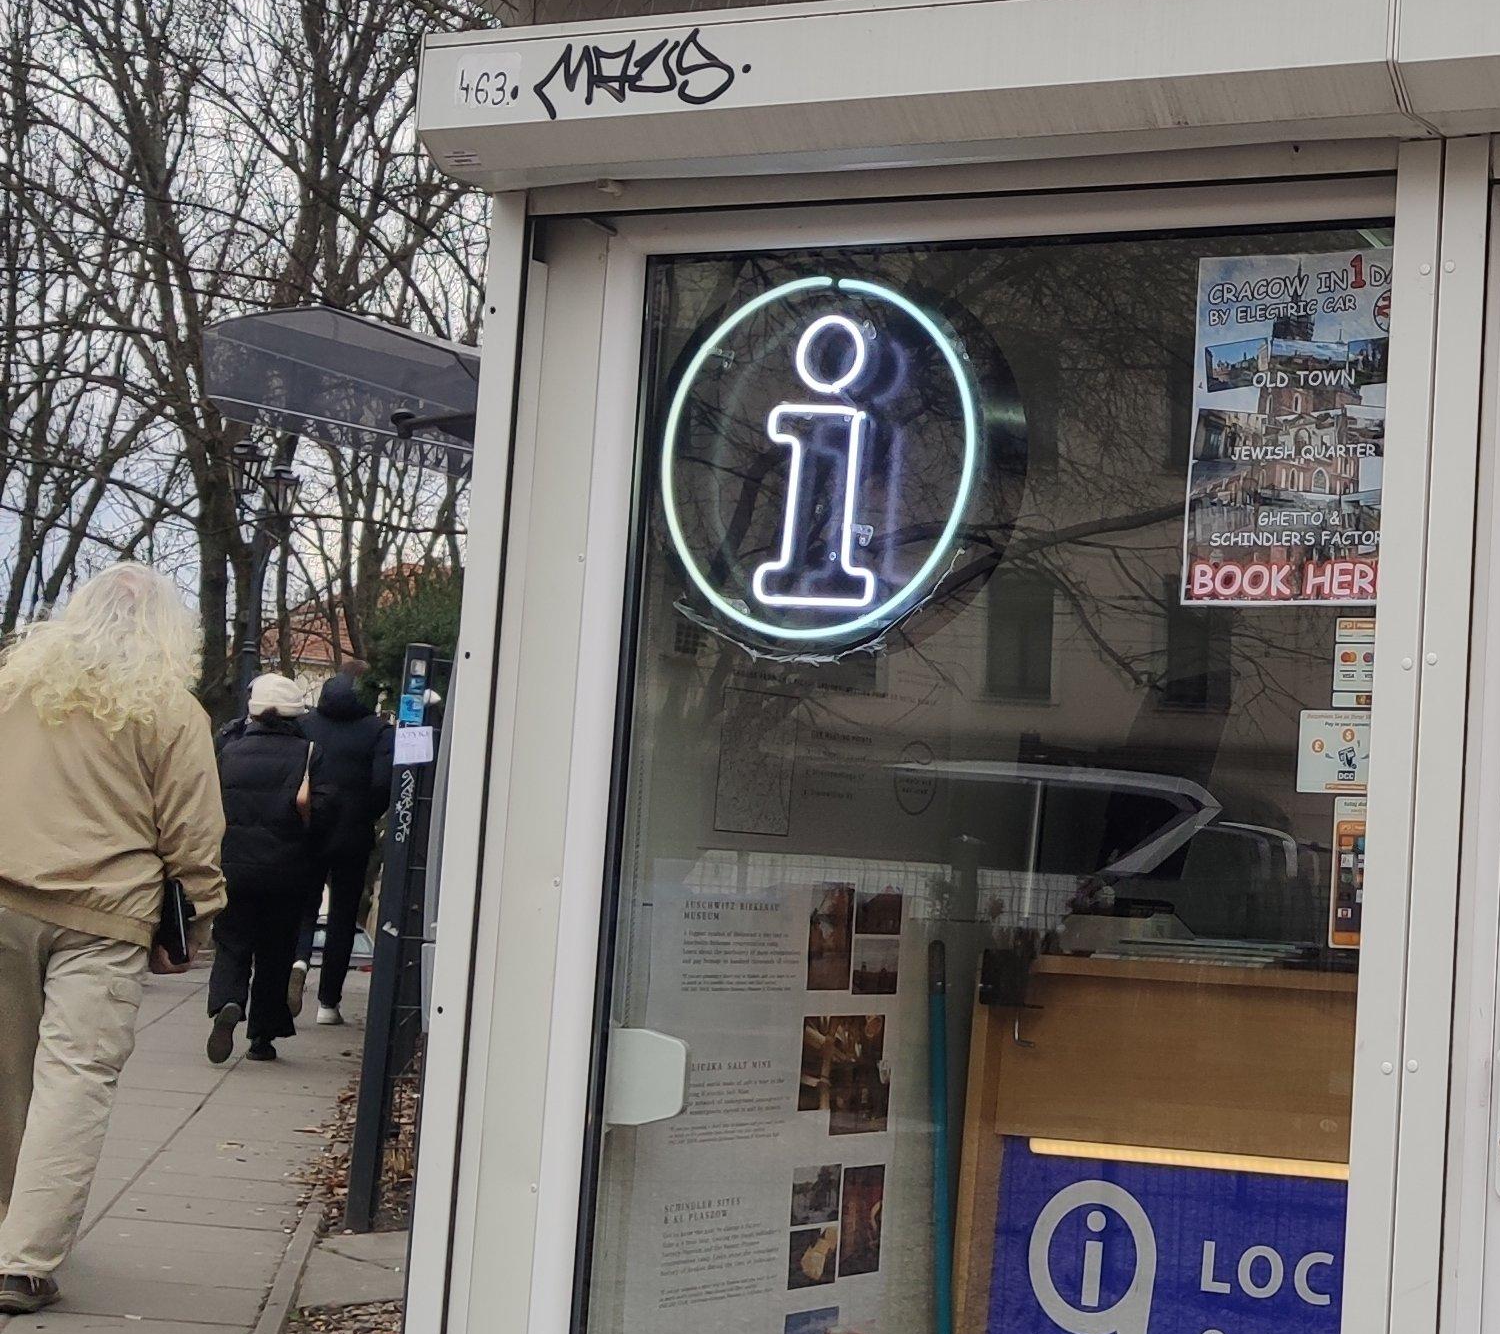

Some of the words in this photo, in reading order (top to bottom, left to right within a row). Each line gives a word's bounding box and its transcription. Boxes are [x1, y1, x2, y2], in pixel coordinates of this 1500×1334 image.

[1208, 273, 1309, 305] CRACOW
[1317, 269, 1349, 294] IN
[1350, 254, 1366, 289] 1
[1208, 308, 1231, 326] BY
[1236, 299, 1318, 324] ELECTRIC
[1322, 295, 1357, 314] CAR
[1252, 370, 1289, 389] OLD
[1300, 368, 1356, 387] TOWN
[1230, 444, 1296, 462] JEWISH
[1301, 442, 1377, 460] QUARTER
[1257, 511, 1324, 526] GHETTO
[1329, 511, 1341, 526] &
[1209, 531, 1315, 547] SCHINDLER'S
[1193, 563, 1292, 596] BOOK
[1305, 562, 1379, 596] HER
[1338, 772, 1355, 780] DCC
[684, 911, 720, 921] MUSEUM
[752, 1060, 772, 1069] MINE
